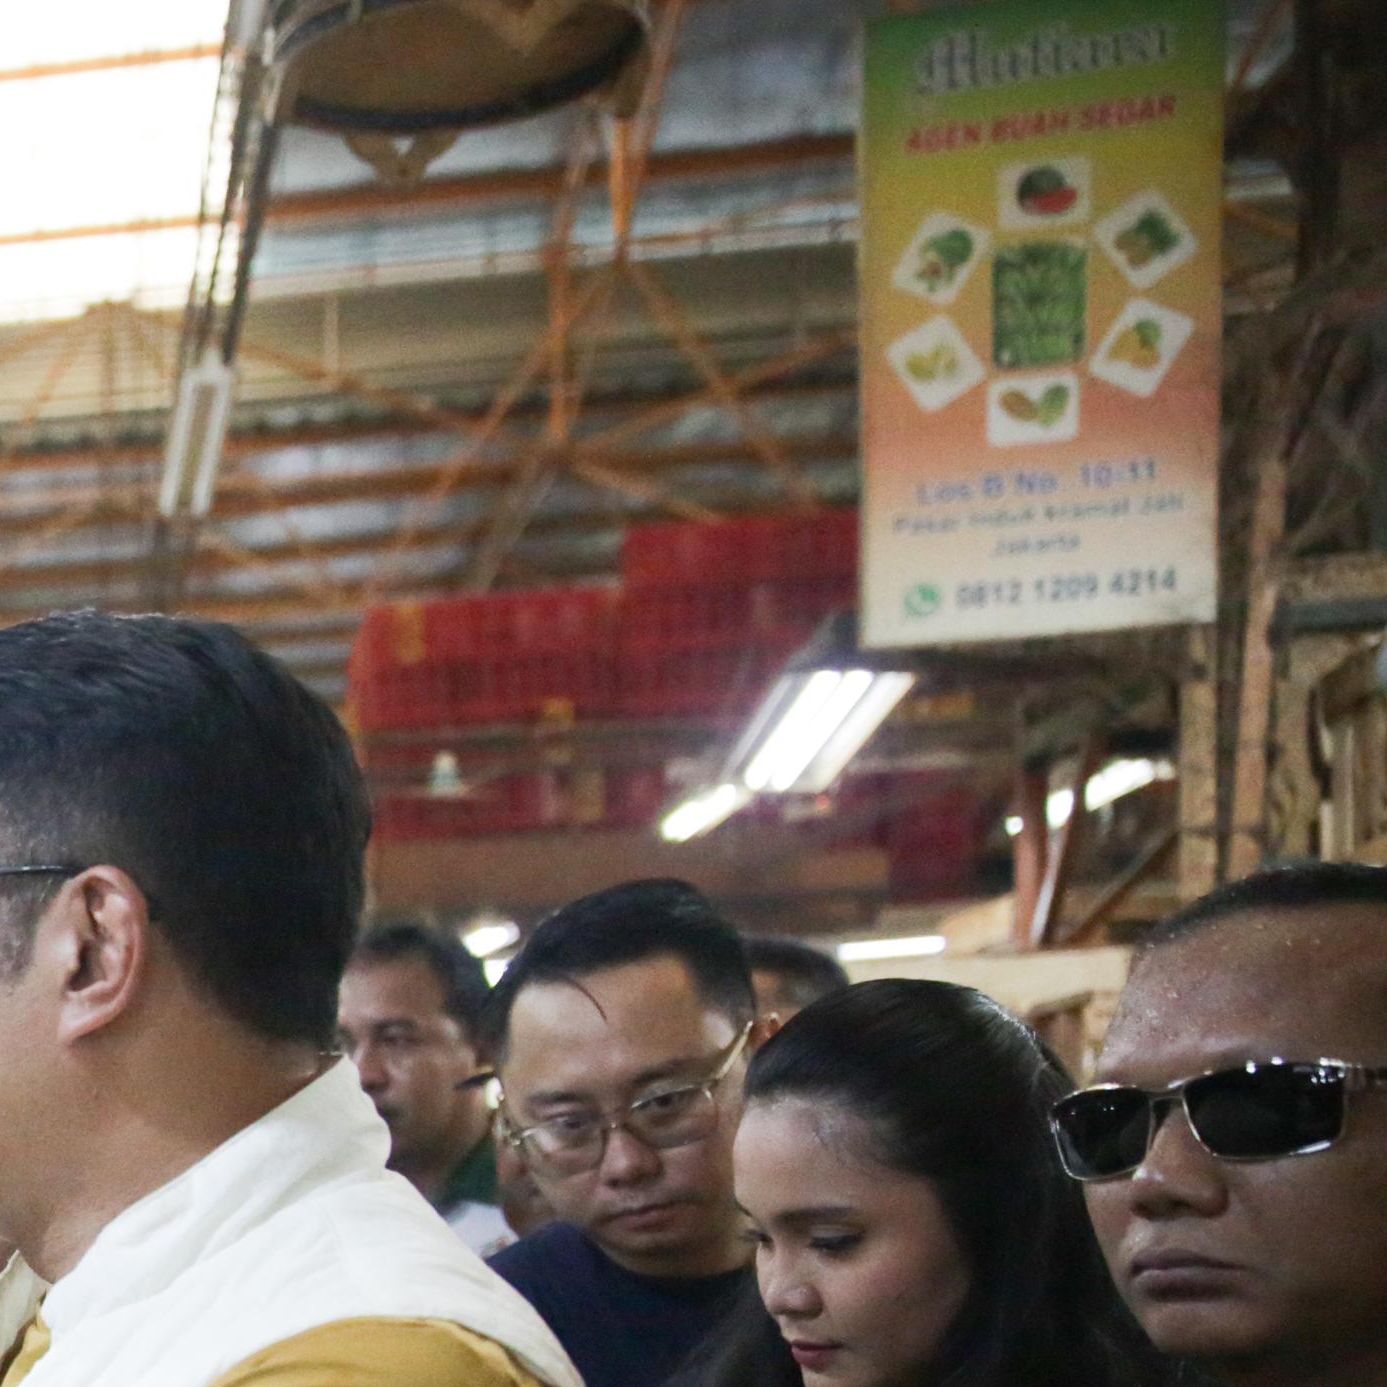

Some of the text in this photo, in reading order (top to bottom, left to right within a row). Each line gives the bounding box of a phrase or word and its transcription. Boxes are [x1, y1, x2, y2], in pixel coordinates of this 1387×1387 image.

[907, 96, 1175, 150] AGEN BUAH SEGAR
[916, 480, 972, 504] Los
[993, 534, 1080, 557] Jakarta
[956, 566, 1177, 608] 0812 1209 4214
